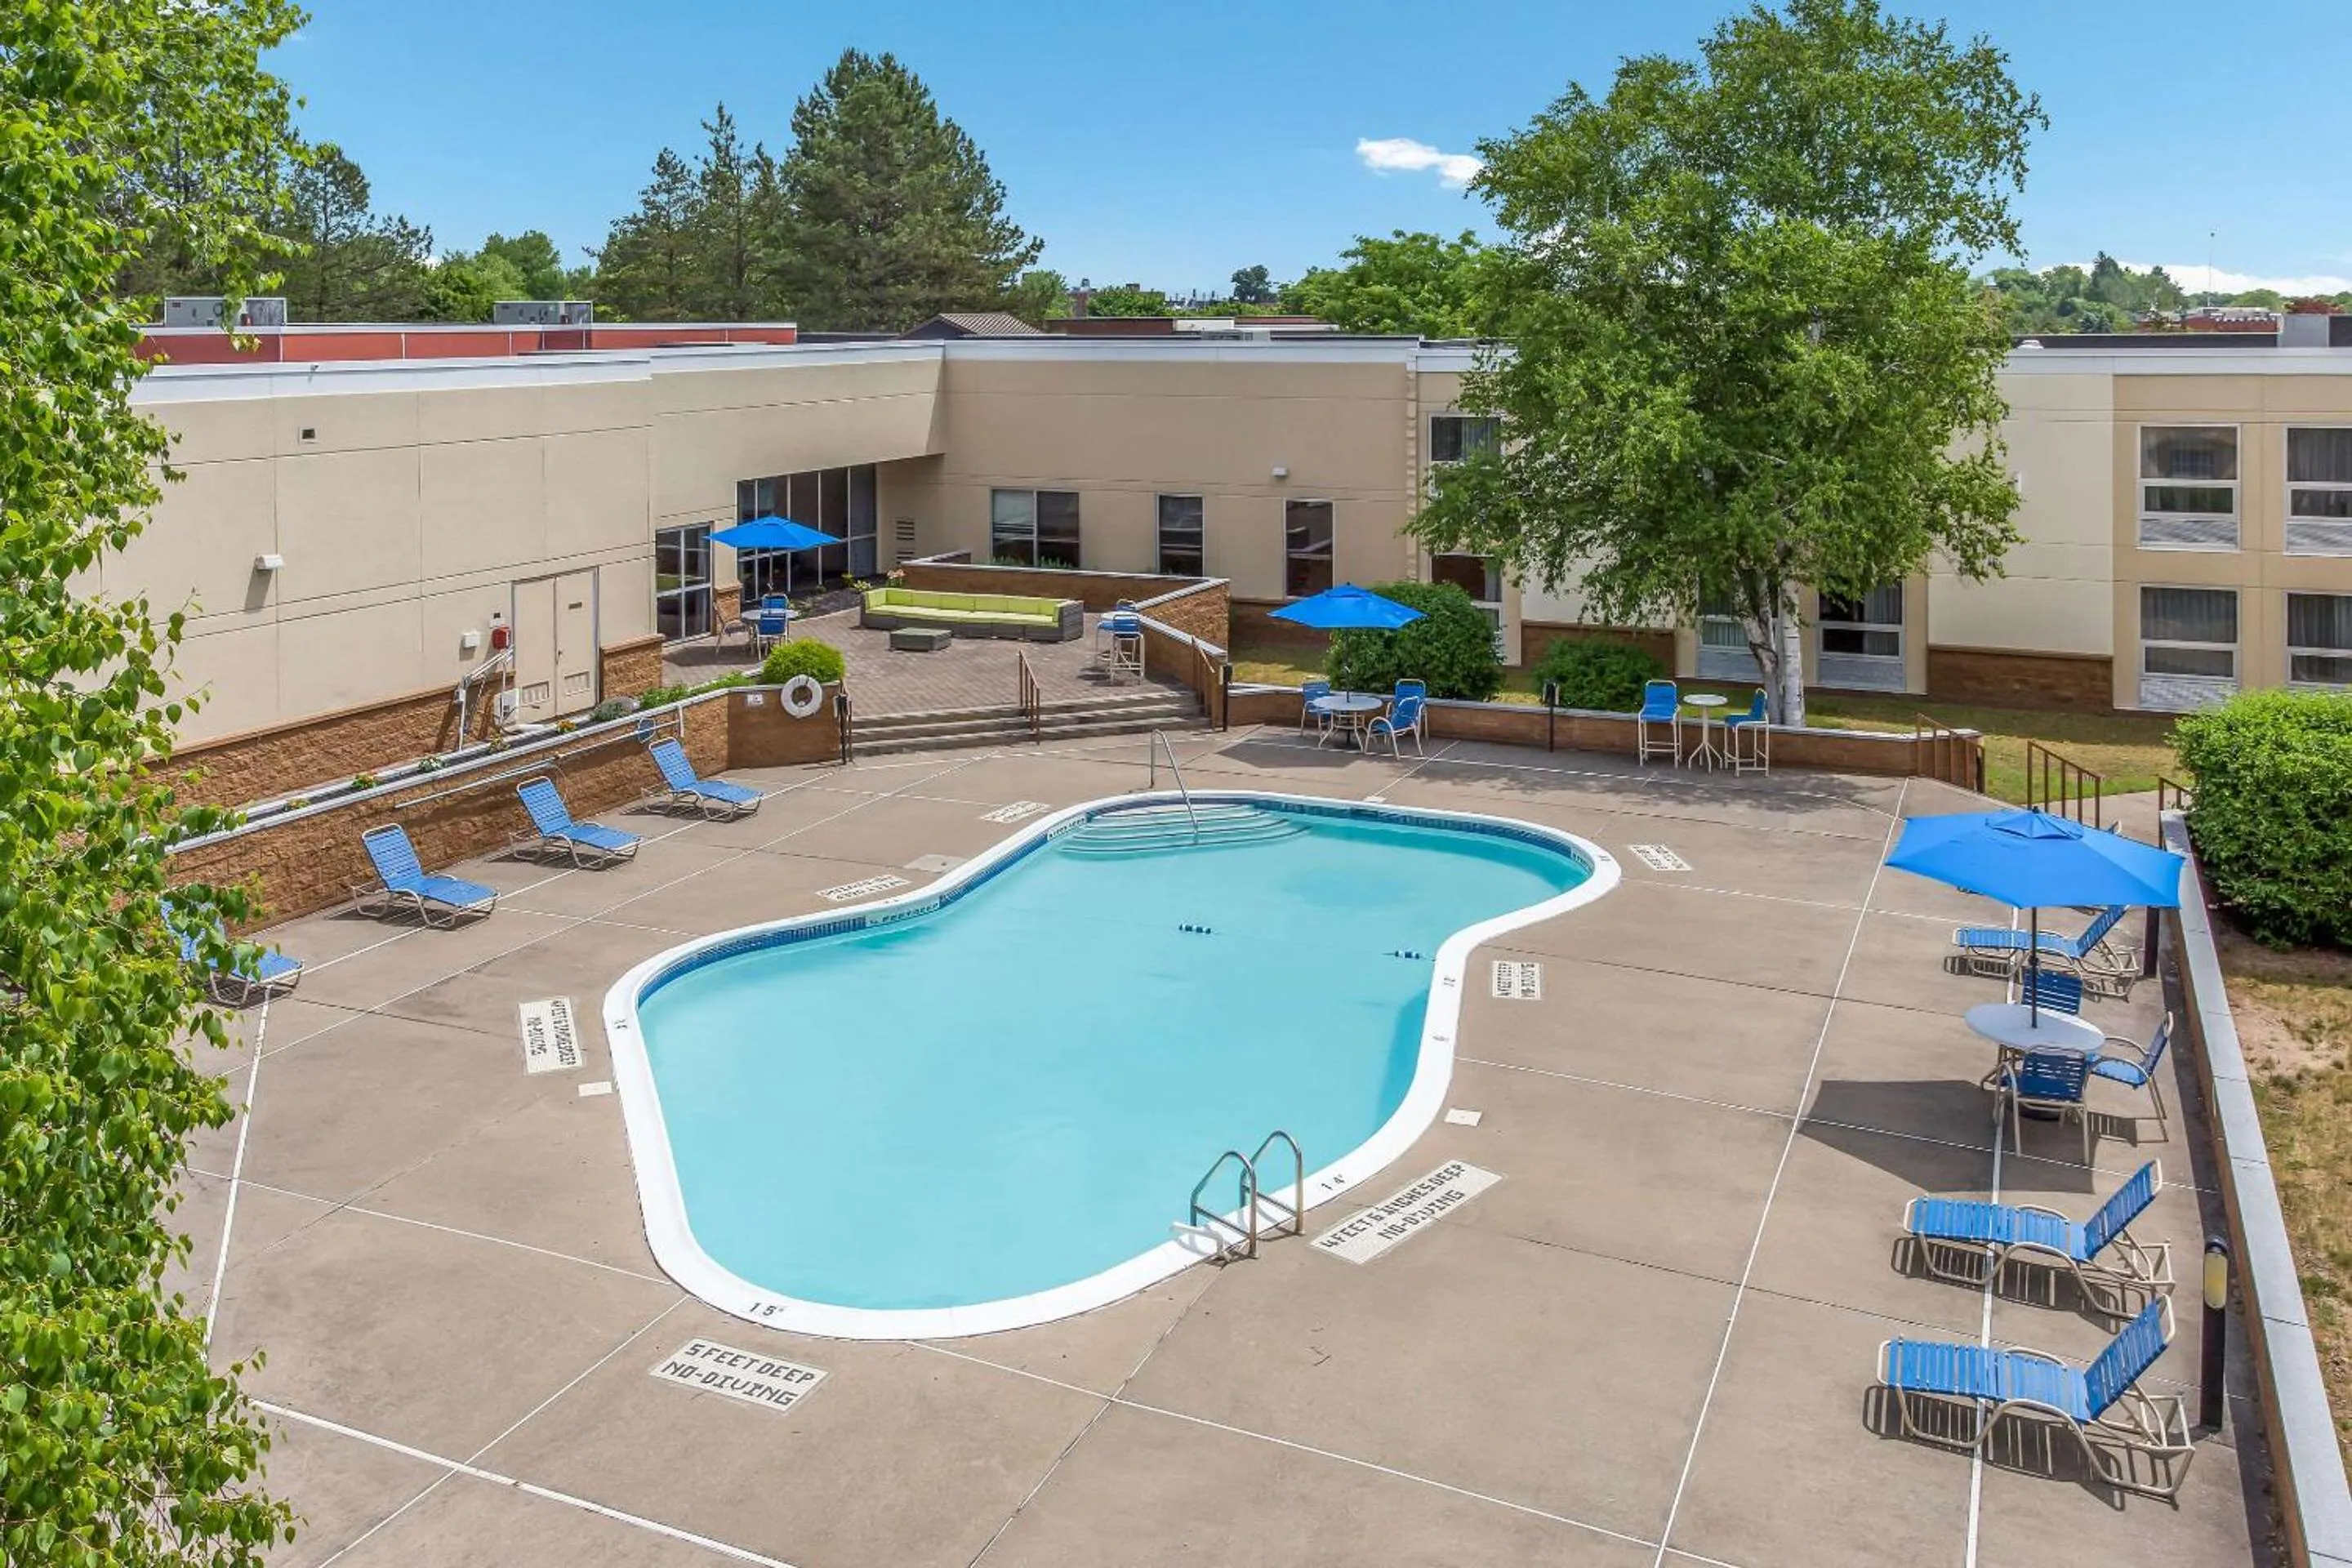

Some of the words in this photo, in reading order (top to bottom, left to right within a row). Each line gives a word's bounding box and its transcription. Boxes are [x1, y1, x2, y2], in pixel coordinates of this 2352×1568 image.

[1332, 1218, 1373, 1242] FEET
[1428, 1164, 1465, 1187] DEEP
[1378, 1189, 1466, 1240] NO-DIVING
[661, 1361, 799, 1405] NO-DIVING
[684, 1343, 706, 1356] 5
[700, 1348, 760, 1370] FEET
[756, 1362, 815, 1384] DEEP
